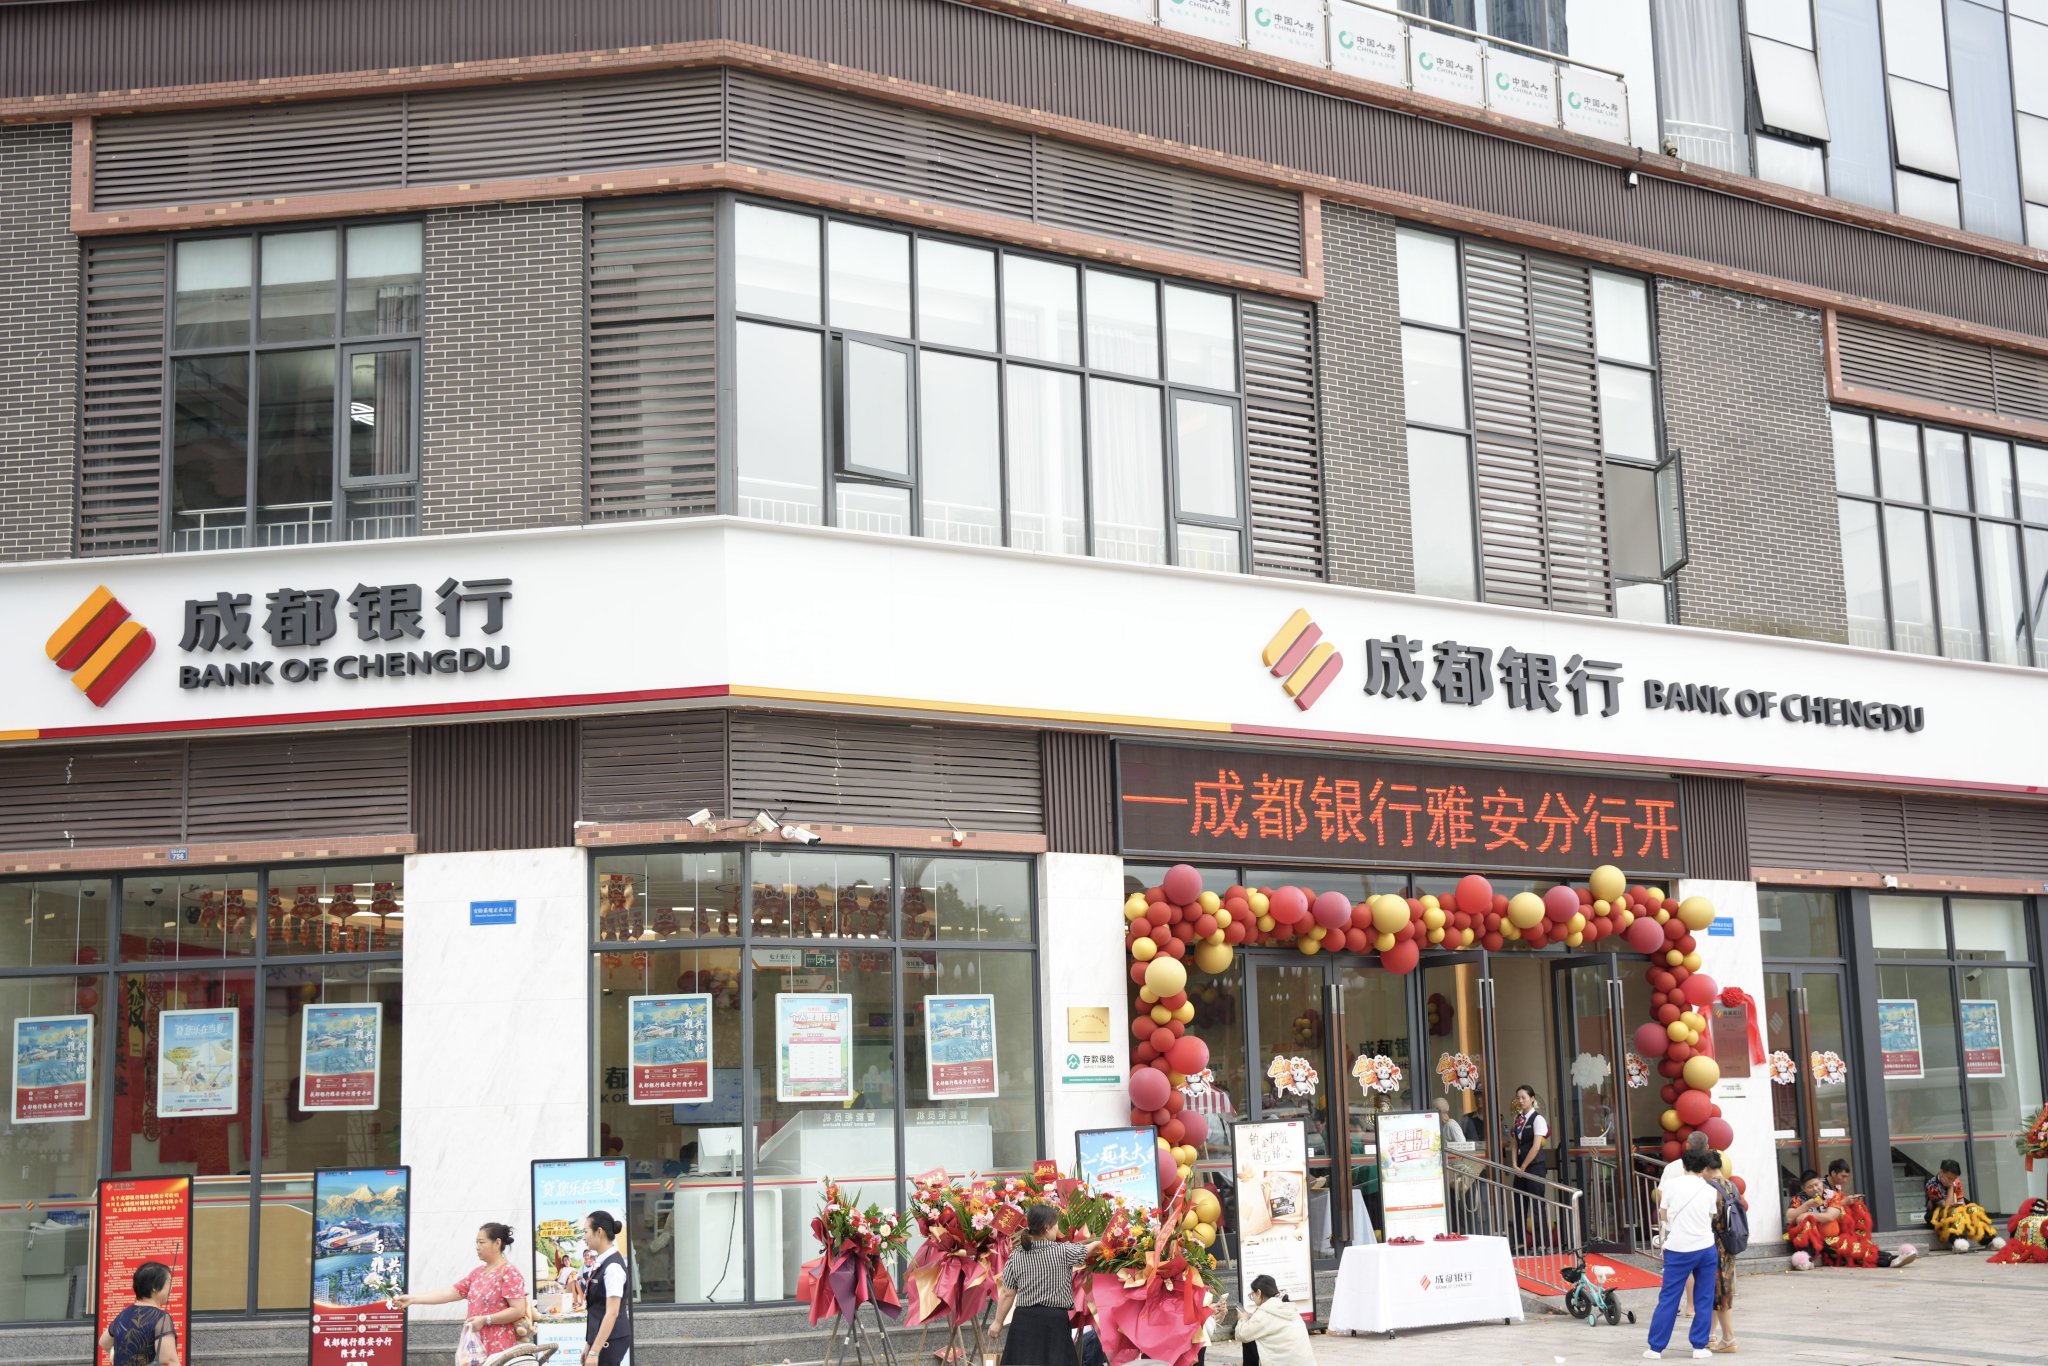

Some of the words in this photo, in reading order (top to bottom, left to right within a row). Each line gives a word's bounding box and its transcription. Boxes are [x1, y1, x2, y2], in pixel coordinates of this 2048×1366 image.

[1274, 13, 1315, 32] 中国人寿
[1356, 36, 1396, 53] 中国人寿
[1436, 57, 1474, 74] 中国人寿
[1512, 77, 1548, 94] 中国人寿
[1583, 96, 1619, 112] 中国人寿
[178, 577, 513, 654] 成都银行
[179, 660, 274, 690] BANK
[280, 657, 329, 684] OF
[333, 645, 512, 681] CHENGDU
[1363, 635, 1625, 718] 成都银行
[1643, 678, 1733, 717] BANK
[1734, 688, 1778, 718] OF
[1780, 693, 1927, 734] CHENGDU
[1083, 1054, 1115, 1064] 存款保险
[1435, 1272, 1473, 1284] 成都银行
[323, 1336, 393, 1348] 成都银行雅安分行
